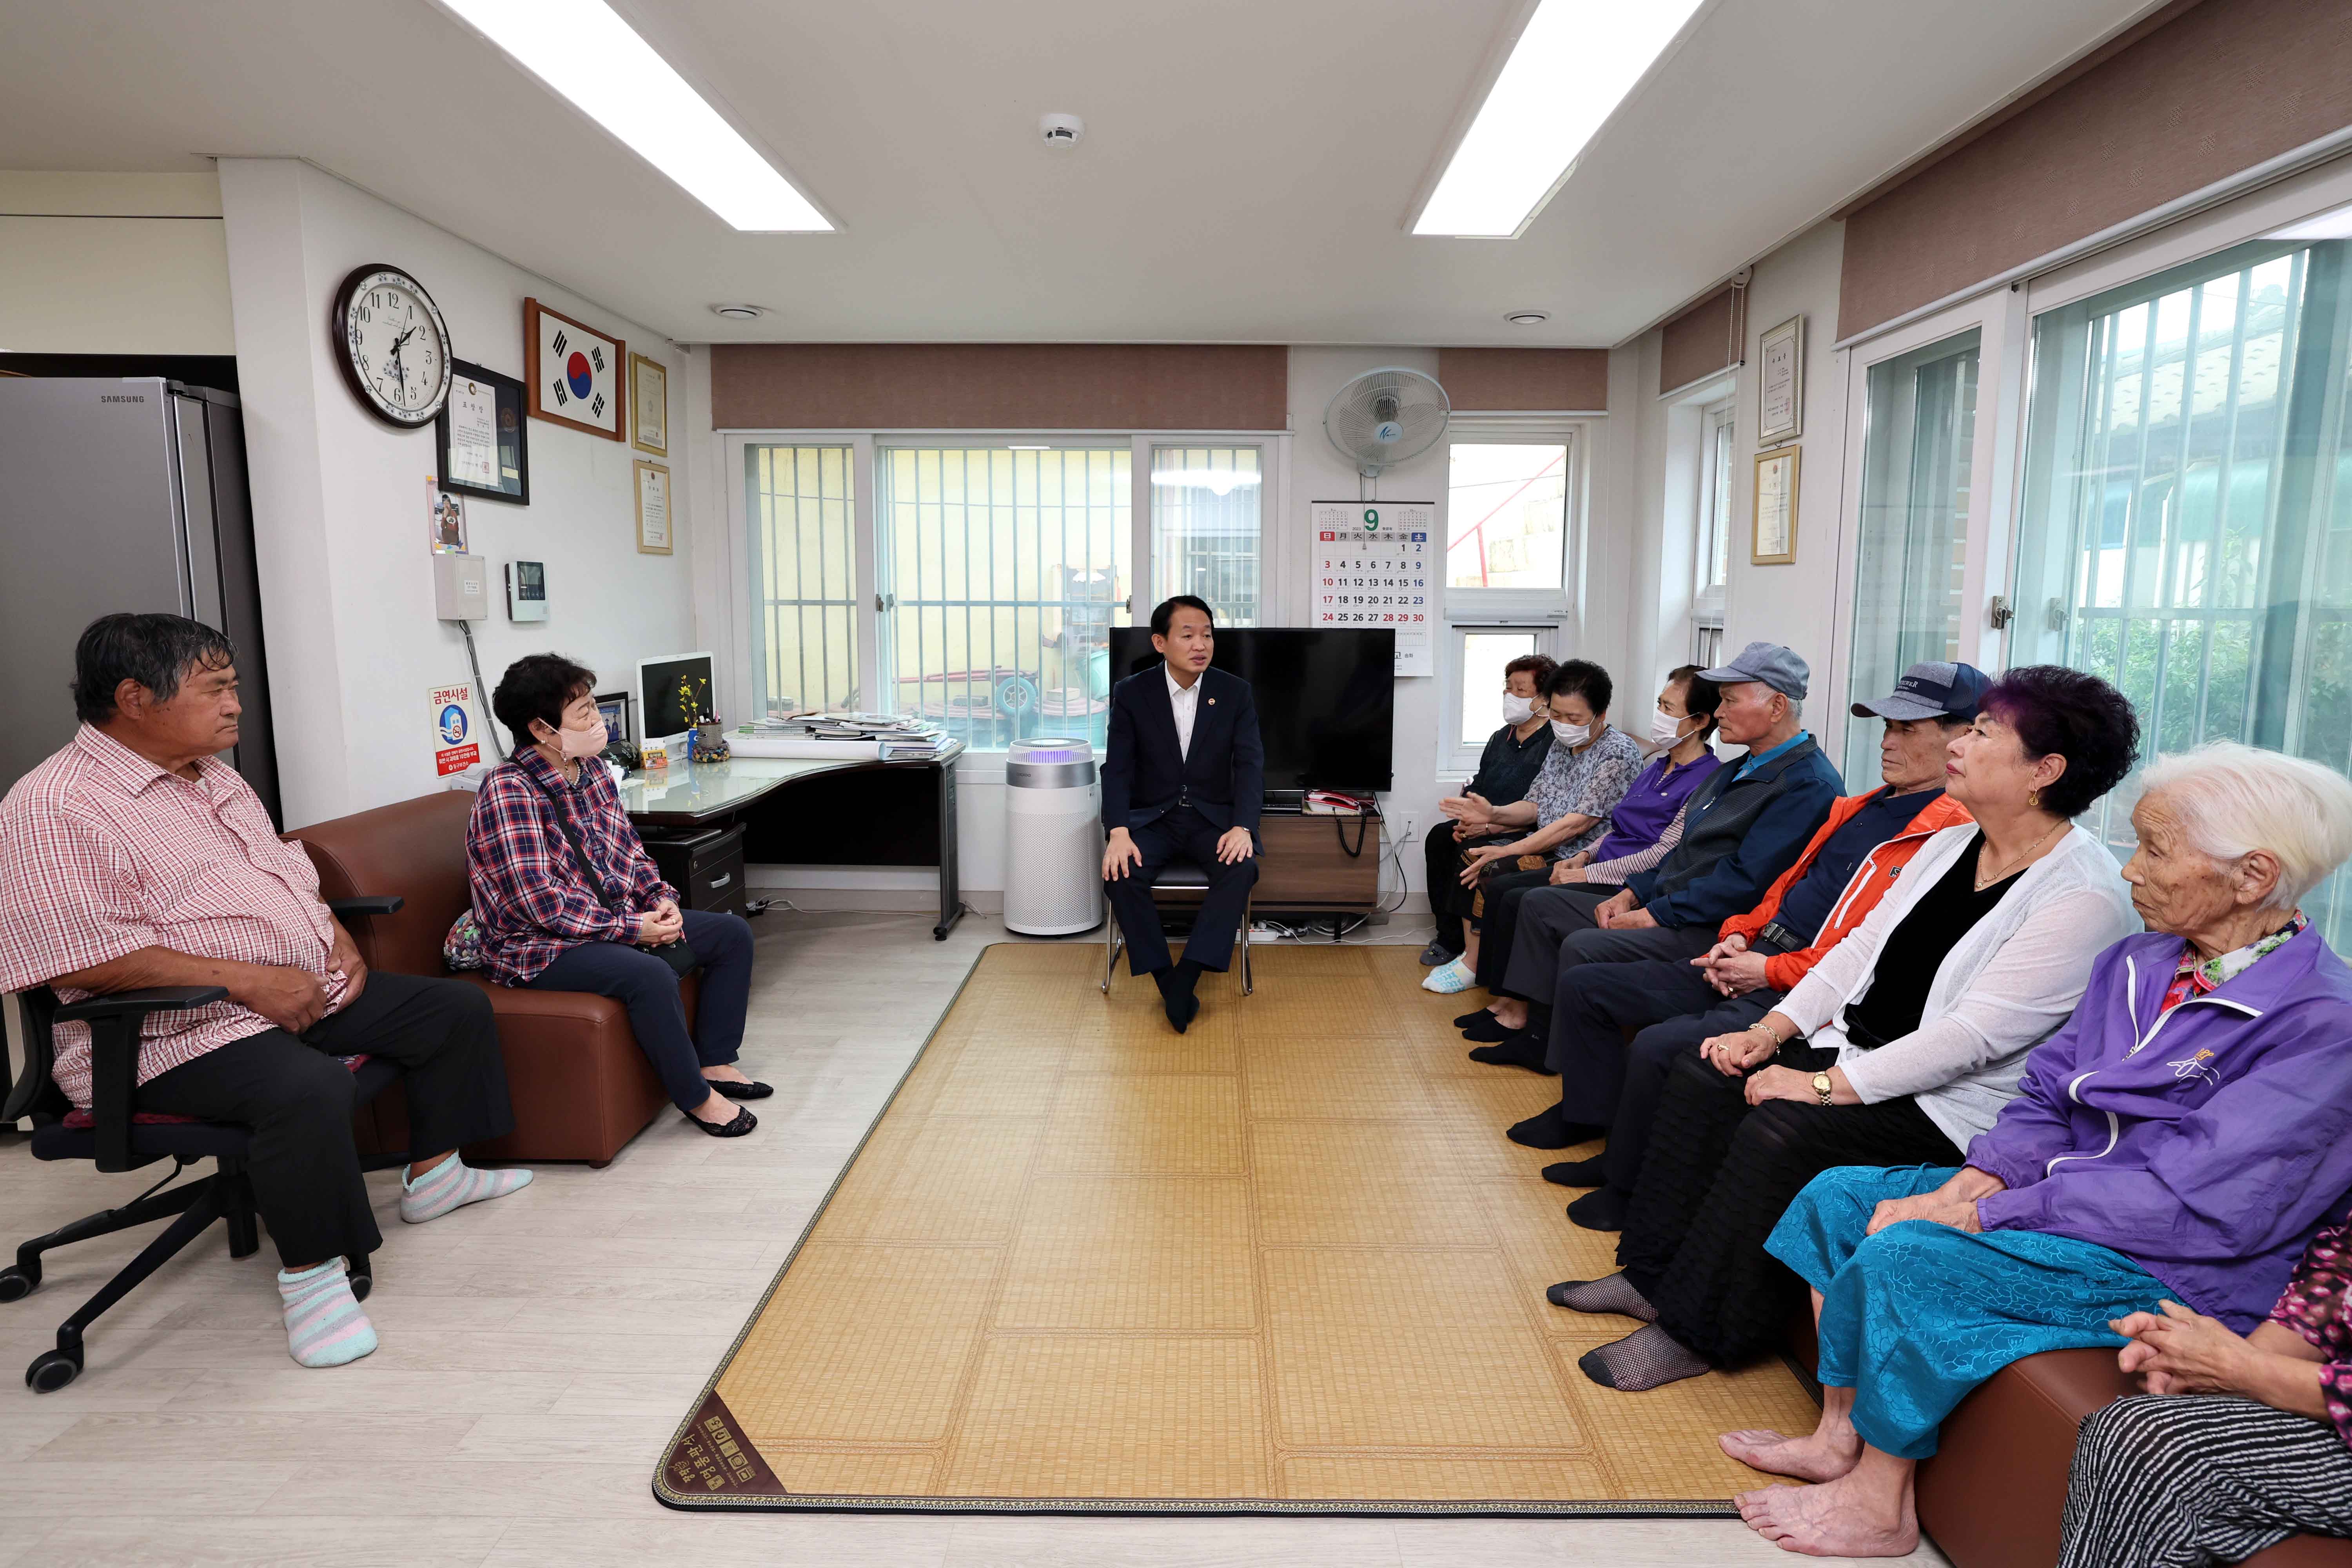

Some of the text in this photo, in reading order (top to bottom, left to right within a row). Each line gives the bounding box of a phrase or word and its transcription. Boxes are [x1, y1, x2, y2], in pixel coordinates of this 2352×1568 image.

[370, 292, 380, 309] 11
[387, 292, 399, 309] 12
[360, 306, 370, 323] 10
[408, 304, 412, 320] 1
[356, 329, 363, 345] 9
[419, 325, 426, 341] 2
[362, 355, 369, 370] 8
[426, 350, 432, 365] 3
[376, 377, 383, 392] 7
[421, 371, 428, 386] 4
[394, 388, 401, 402] 6
[410, 386, 417, 400] 5
[1364, 510, 1378, 531] 9
[434, 687, 468, 704] 금연시설
